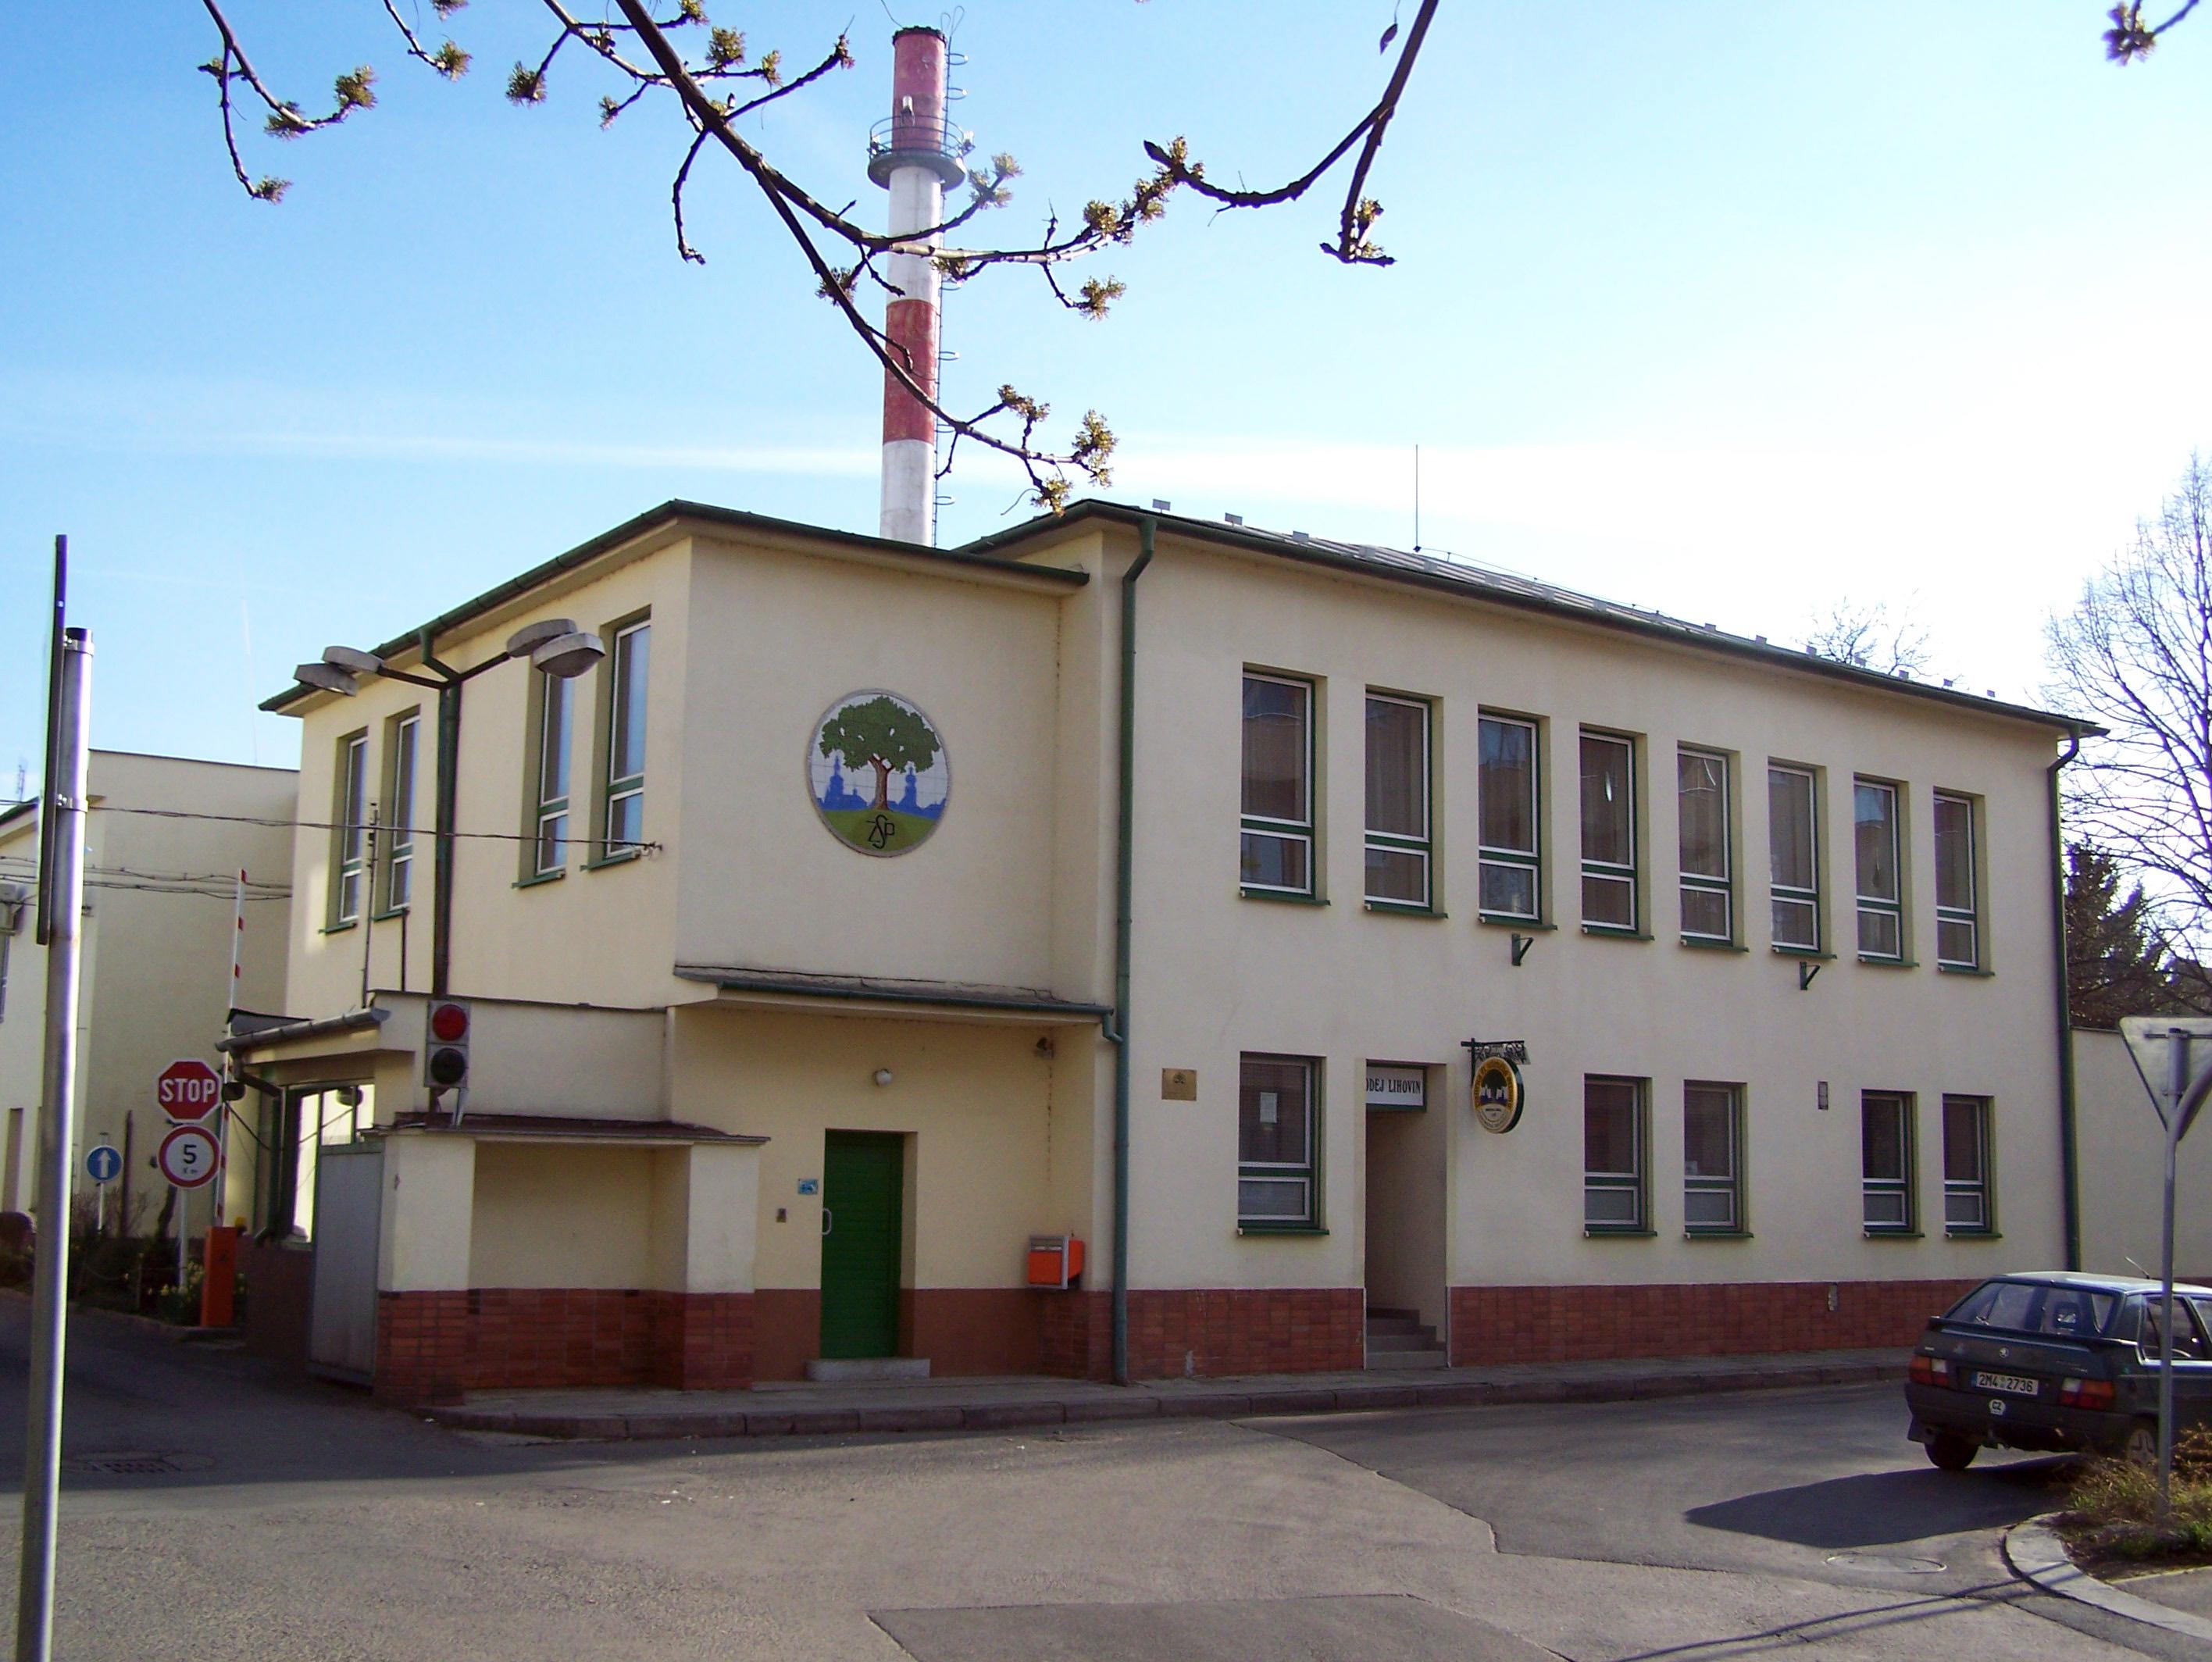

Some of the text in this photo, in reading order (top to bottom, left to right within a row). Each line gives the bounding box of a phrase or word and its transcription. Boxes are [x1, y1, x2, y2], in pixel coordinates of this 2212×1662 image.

[161, 1078, 216, 1103] STOP
[1389, 1079, 1420, 1093] LIHOVIN
[184, 1144, 197, 1164] 5
[1979, 1375, 2032, 1393] 2M4 2736
